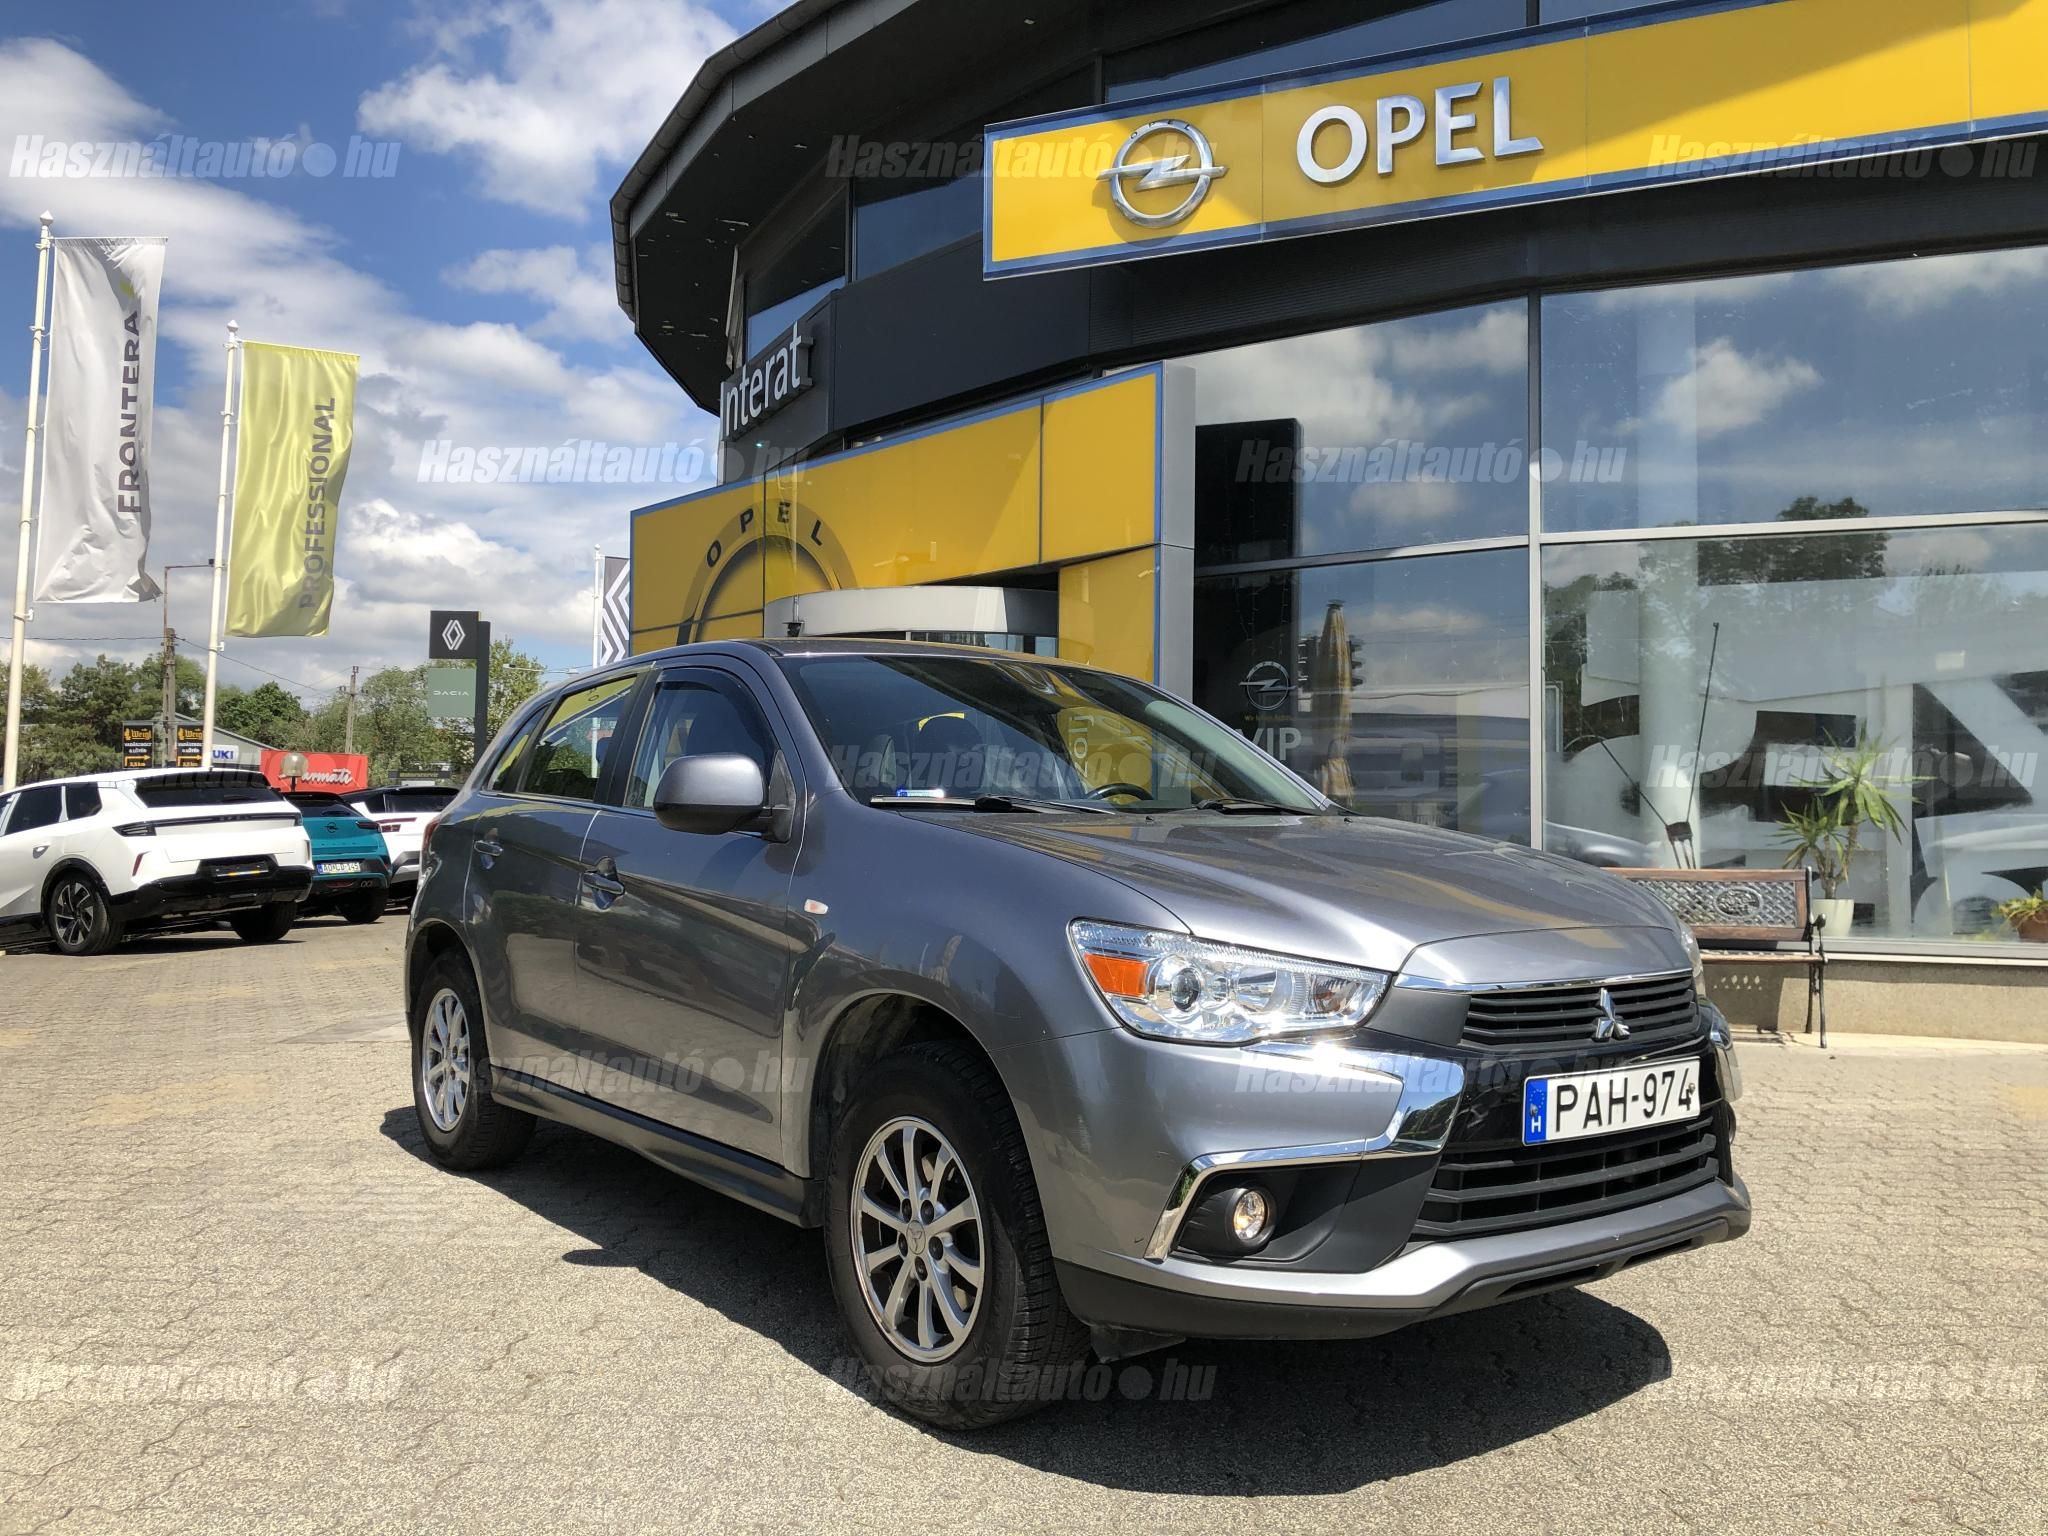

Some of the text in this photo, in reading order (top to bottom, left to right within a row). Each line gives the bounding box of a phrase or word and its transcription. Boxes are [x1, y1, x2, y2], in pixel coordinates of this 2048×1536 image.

[1130, 119, 1191, 140] OPEL
[1296, 76, 1545, 185] OPEL
[117, 310, 142, 513] FRONTERA
[720, 320, 802, 439] Interat
[299, 397, 336, 608] PROFESSIONAL
[706, 501, 823, 569] OPEL
[212, 749, 234, 760] UKI
[1531, 1067, 1696, 1133] H PAH-974
